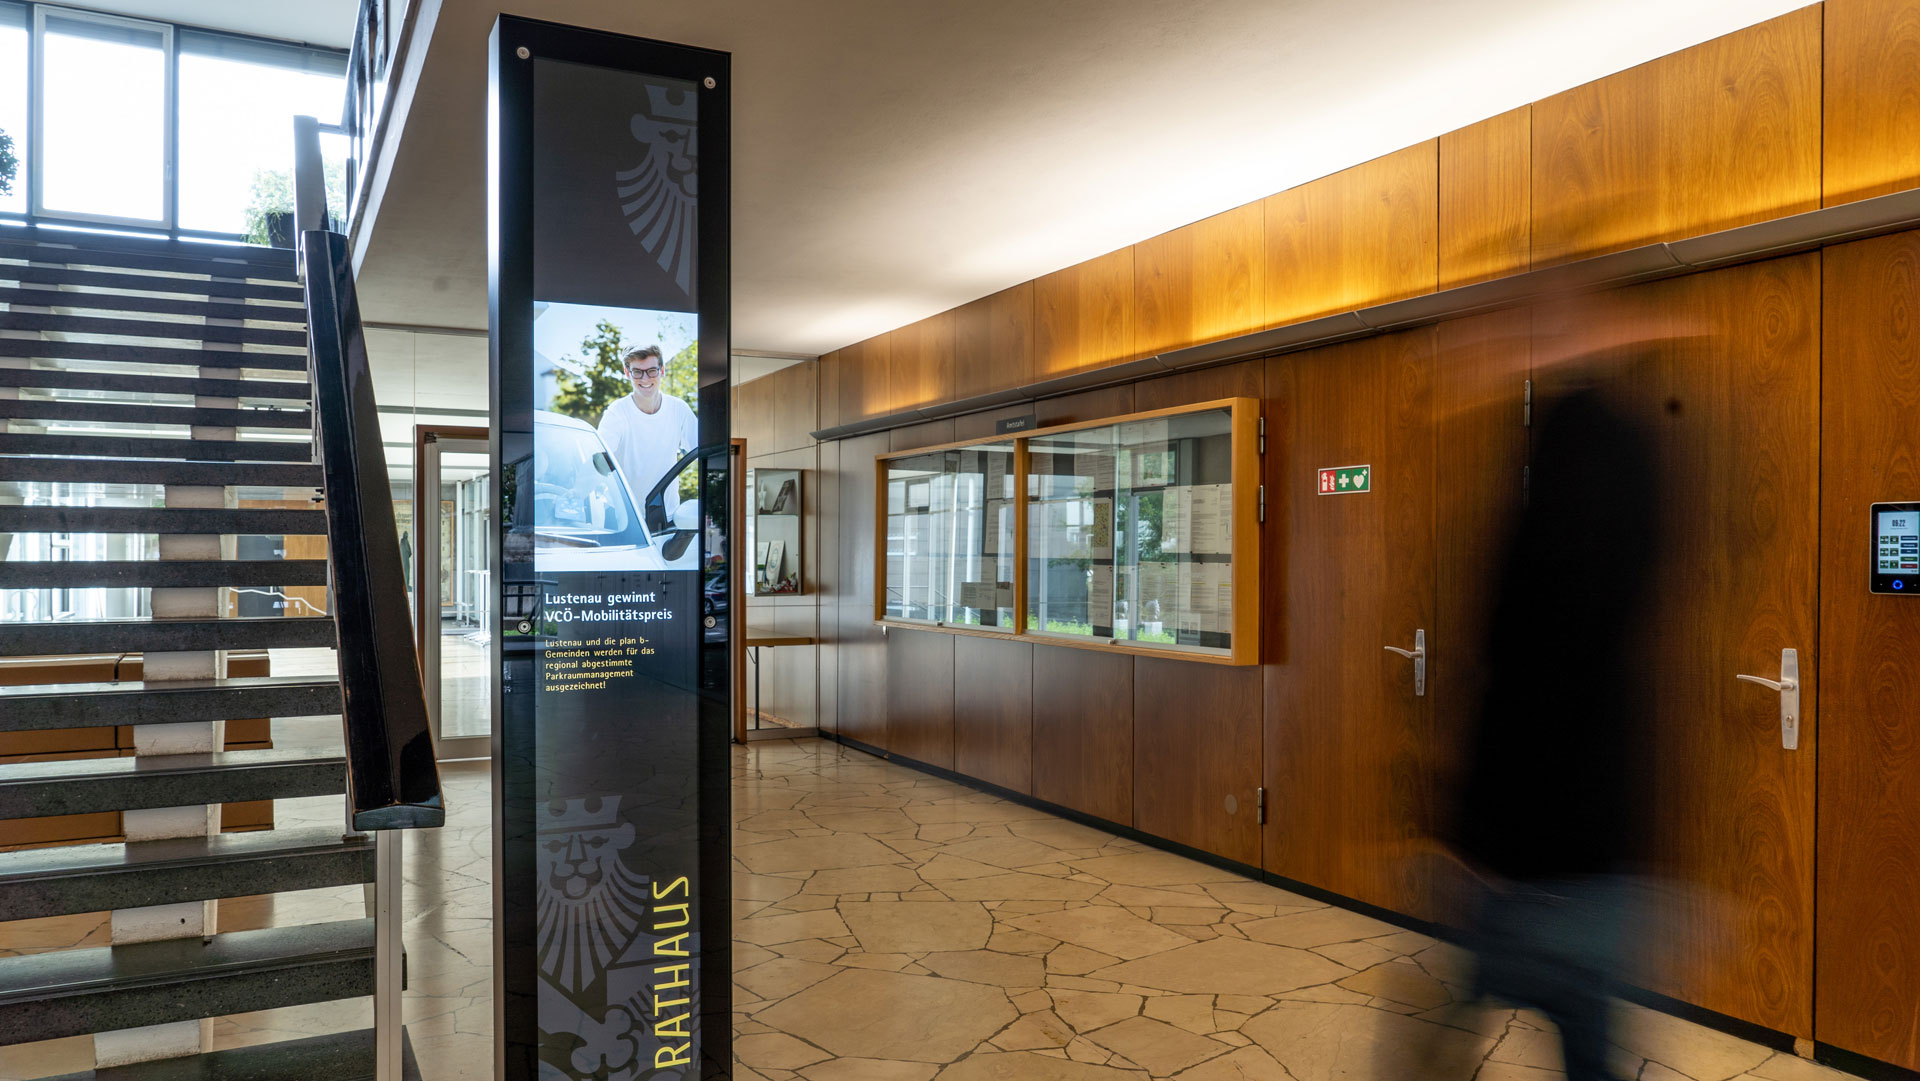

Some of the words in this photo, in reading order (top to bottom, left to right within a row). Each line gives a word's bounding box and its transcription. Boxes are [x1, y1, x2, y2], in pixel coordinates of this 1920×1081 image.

[545, 593, 602, 605] Lustenau
[607, 591, 656, 606] gewinnt
[545, 608, 673, 623] VCÖ-Mobilitätspreis
[545, 639, 582, 648] Lustenau
[586, 638, 600, 646] und
[604, 637, 616, 646] die
[619, 637, 636, 646] plan
[639, 636, 649, 644] b-
[545, 650, 590, 658] Gemeinden
[594, 648, 623, 656] werden
[626, 647, 638, 655] für
[641, 646, 655, 654] das
[545, 660, 578, 671] regional
[582, 659, 633, 670] abgestimmte
[545, 670, 634, 680] Parkraummanagement
[545, 680, 606, 692] ausgezeichnet!
[653, 876, 690, 1069] RATHAUS
